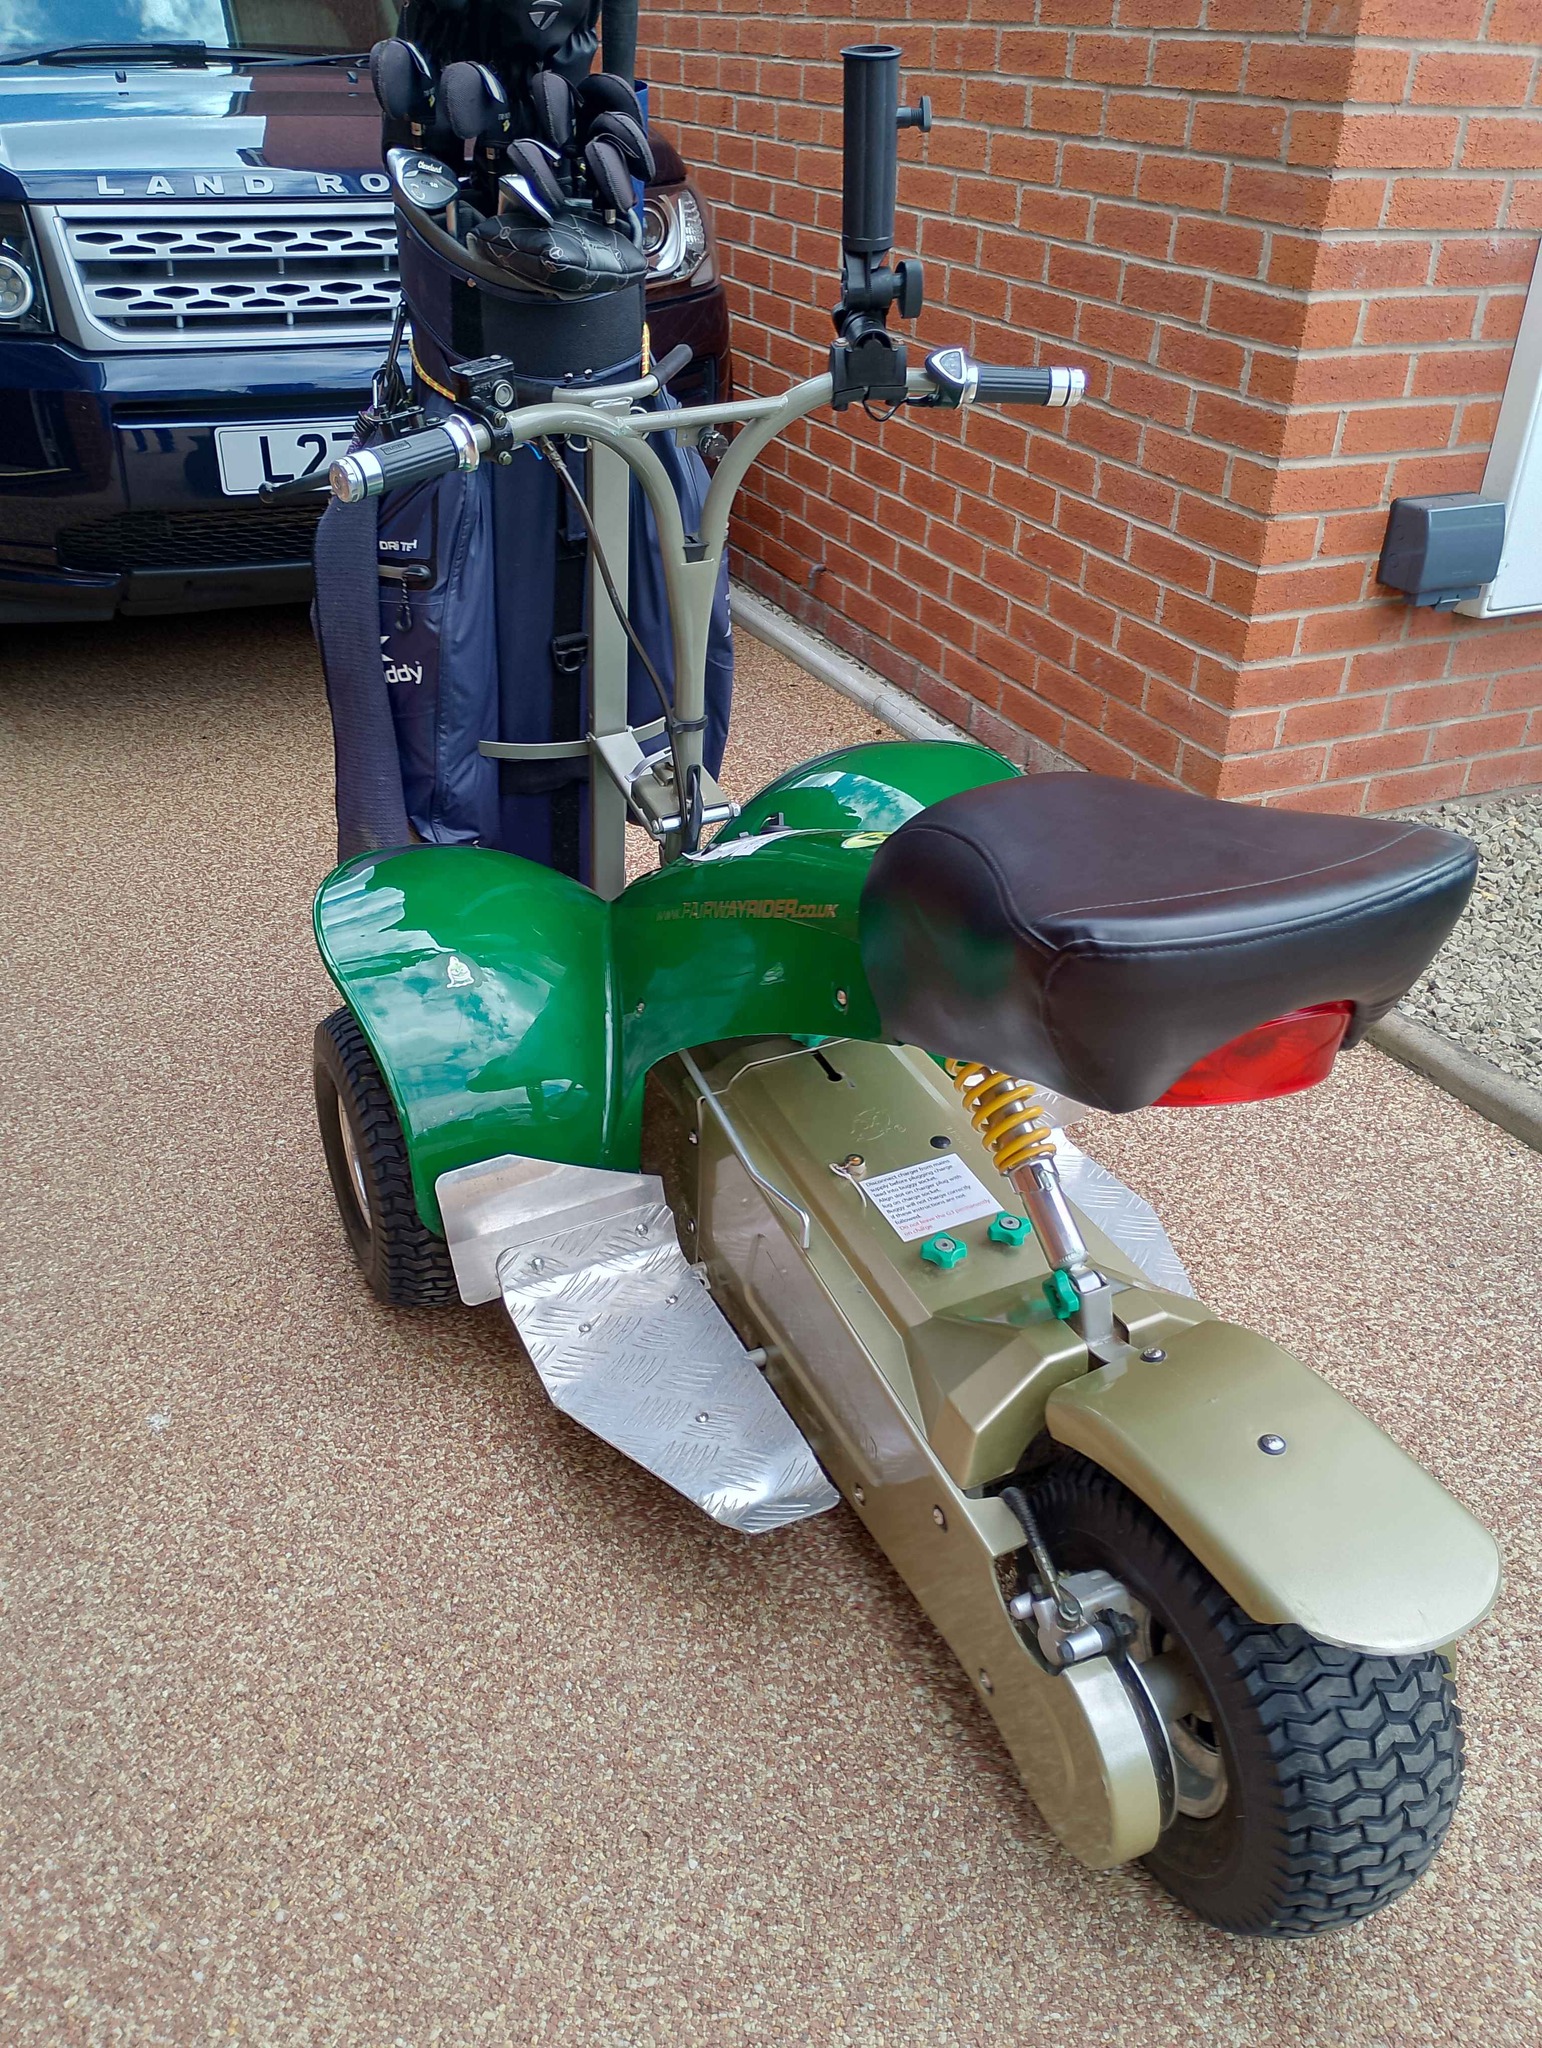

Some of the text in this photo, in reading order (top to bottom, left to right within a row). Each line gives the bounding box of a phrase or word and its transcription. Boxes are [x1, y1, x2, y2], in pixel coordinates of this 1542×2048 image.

[96, 173, 391, 196] LAND RO
[897, 1168, 919, 1177] charger
[889, 1178, 907, 1186] before
[898, 1181, 918, 1190] buggy
[901, 1194, 921, 1202] charge
